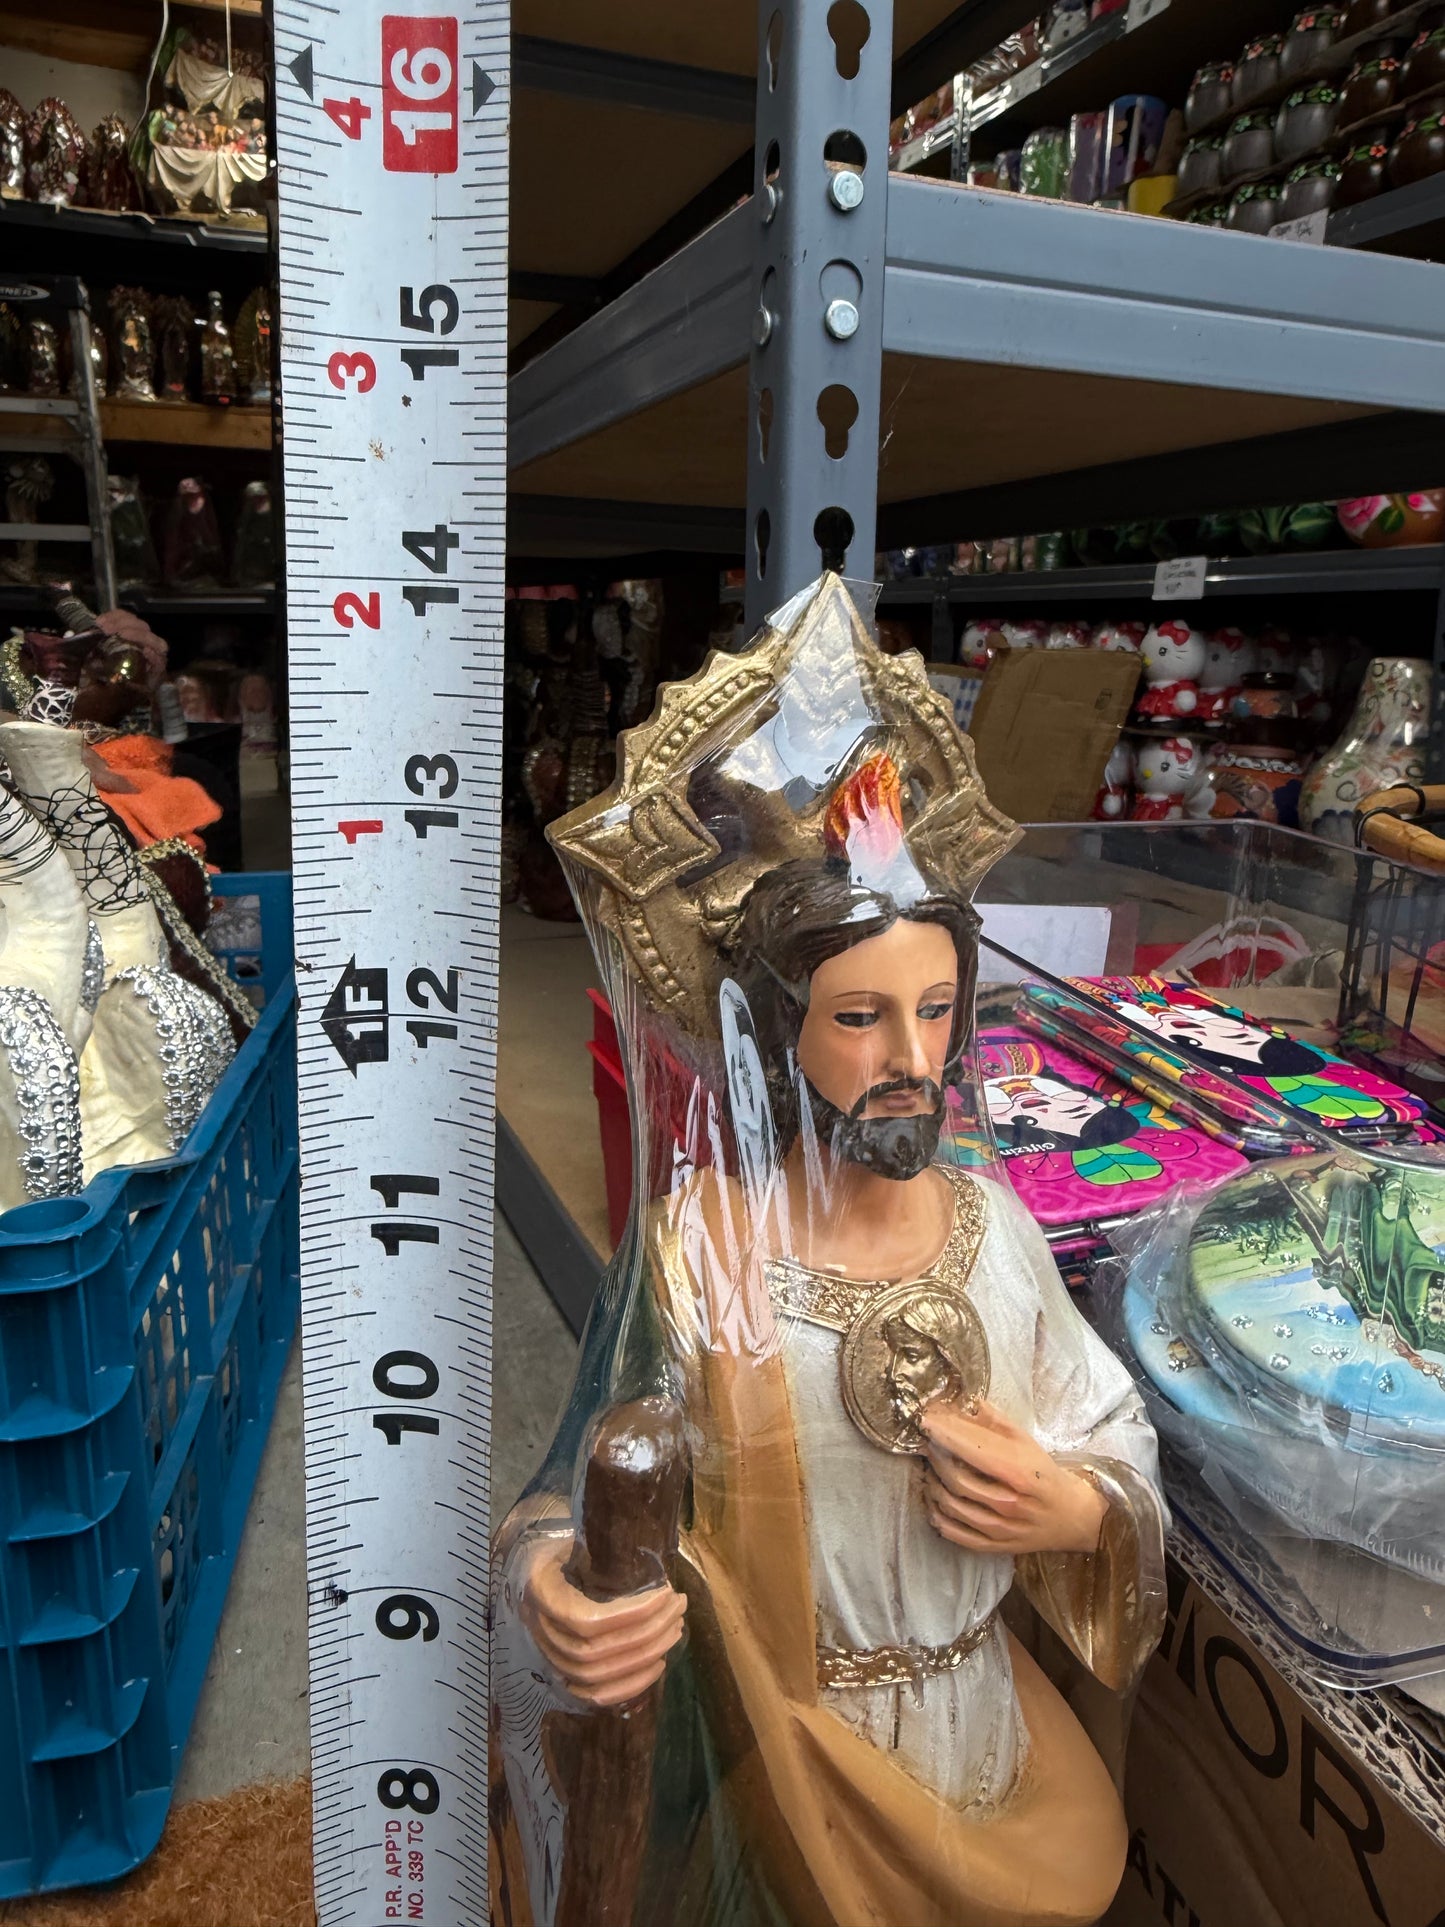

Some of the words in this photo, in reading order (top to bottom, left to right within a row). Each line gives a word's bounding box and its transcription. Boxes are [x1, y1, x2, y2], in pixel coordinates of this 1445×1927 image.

[323, 97, 372, 141] 4
[390, 47, 453, 146] 16
[399, 284, 460, 381] 15
[327, 351, 377, 394] 3
[402, 524, 460, 617] 14
[332, 591, 381, 630] 2
[404, 753, 460, 840] 13
[337, 819, 384, 845] 1
[344, 985, 384, 1041] 1F
[405, 967, 459, 1049] 12
[370, 1174, 440, 1256] 11
[372, 1350, 440, 1446] 10
[375, 1594, 441, 1643] 9
[377, 1767, 441, 1815] 8
[385, 1820, 402, 1878] APP'D
[407, 1820, 425, 1845] TC
[407, 1850, 425, 1882] 339
[385, 1884, 402, 1918] P.R.
[407, 1888, 424, 1920] NO.
